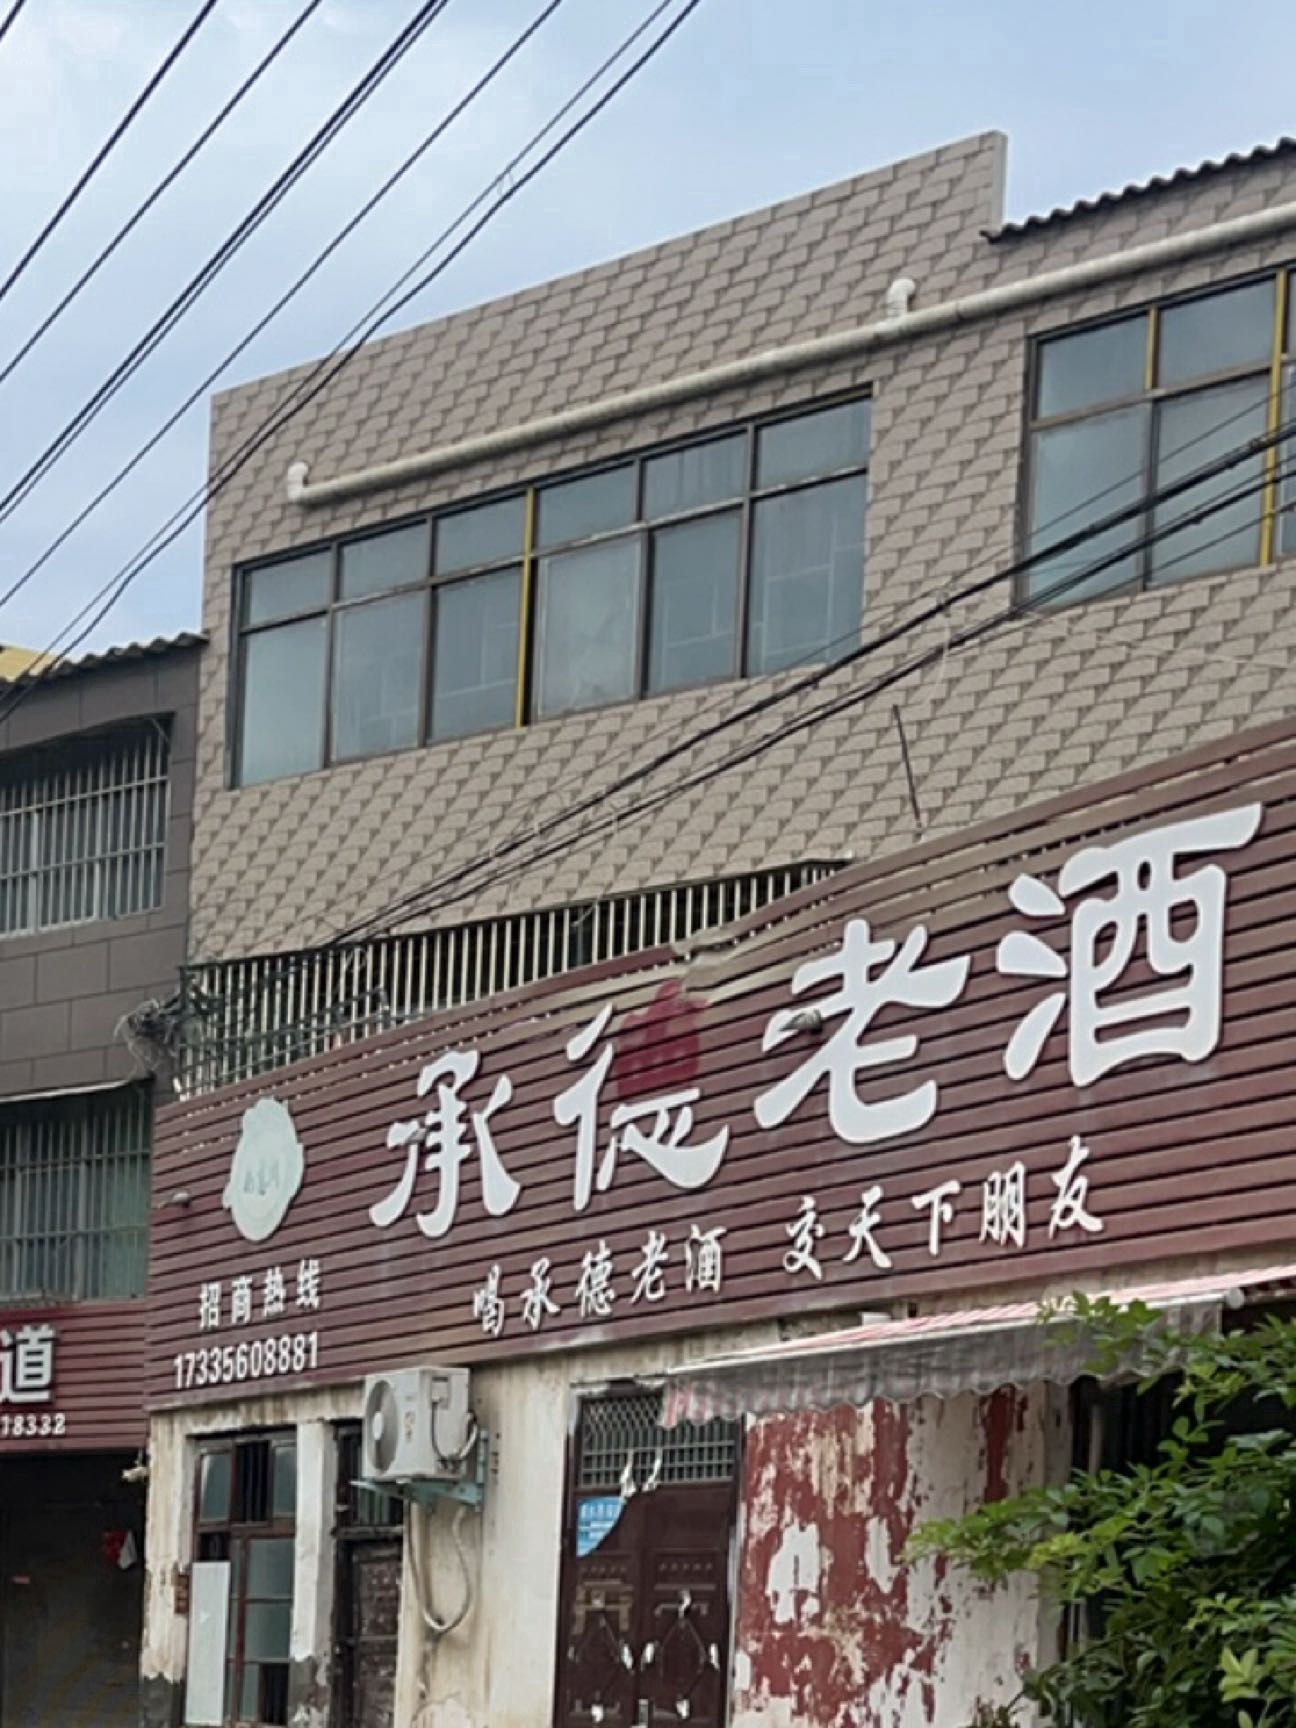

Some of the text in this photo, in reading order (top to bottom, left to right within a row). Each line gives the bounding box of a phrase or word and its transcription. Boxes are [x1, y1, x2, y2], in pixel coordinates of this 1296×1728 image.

[472, 1134, 1104, 1338] 喝承德老酒 交天下朋友
[199, 1258, 320, 1331] 招商热线
[173, 1331, 319, 1390] 17335608881
